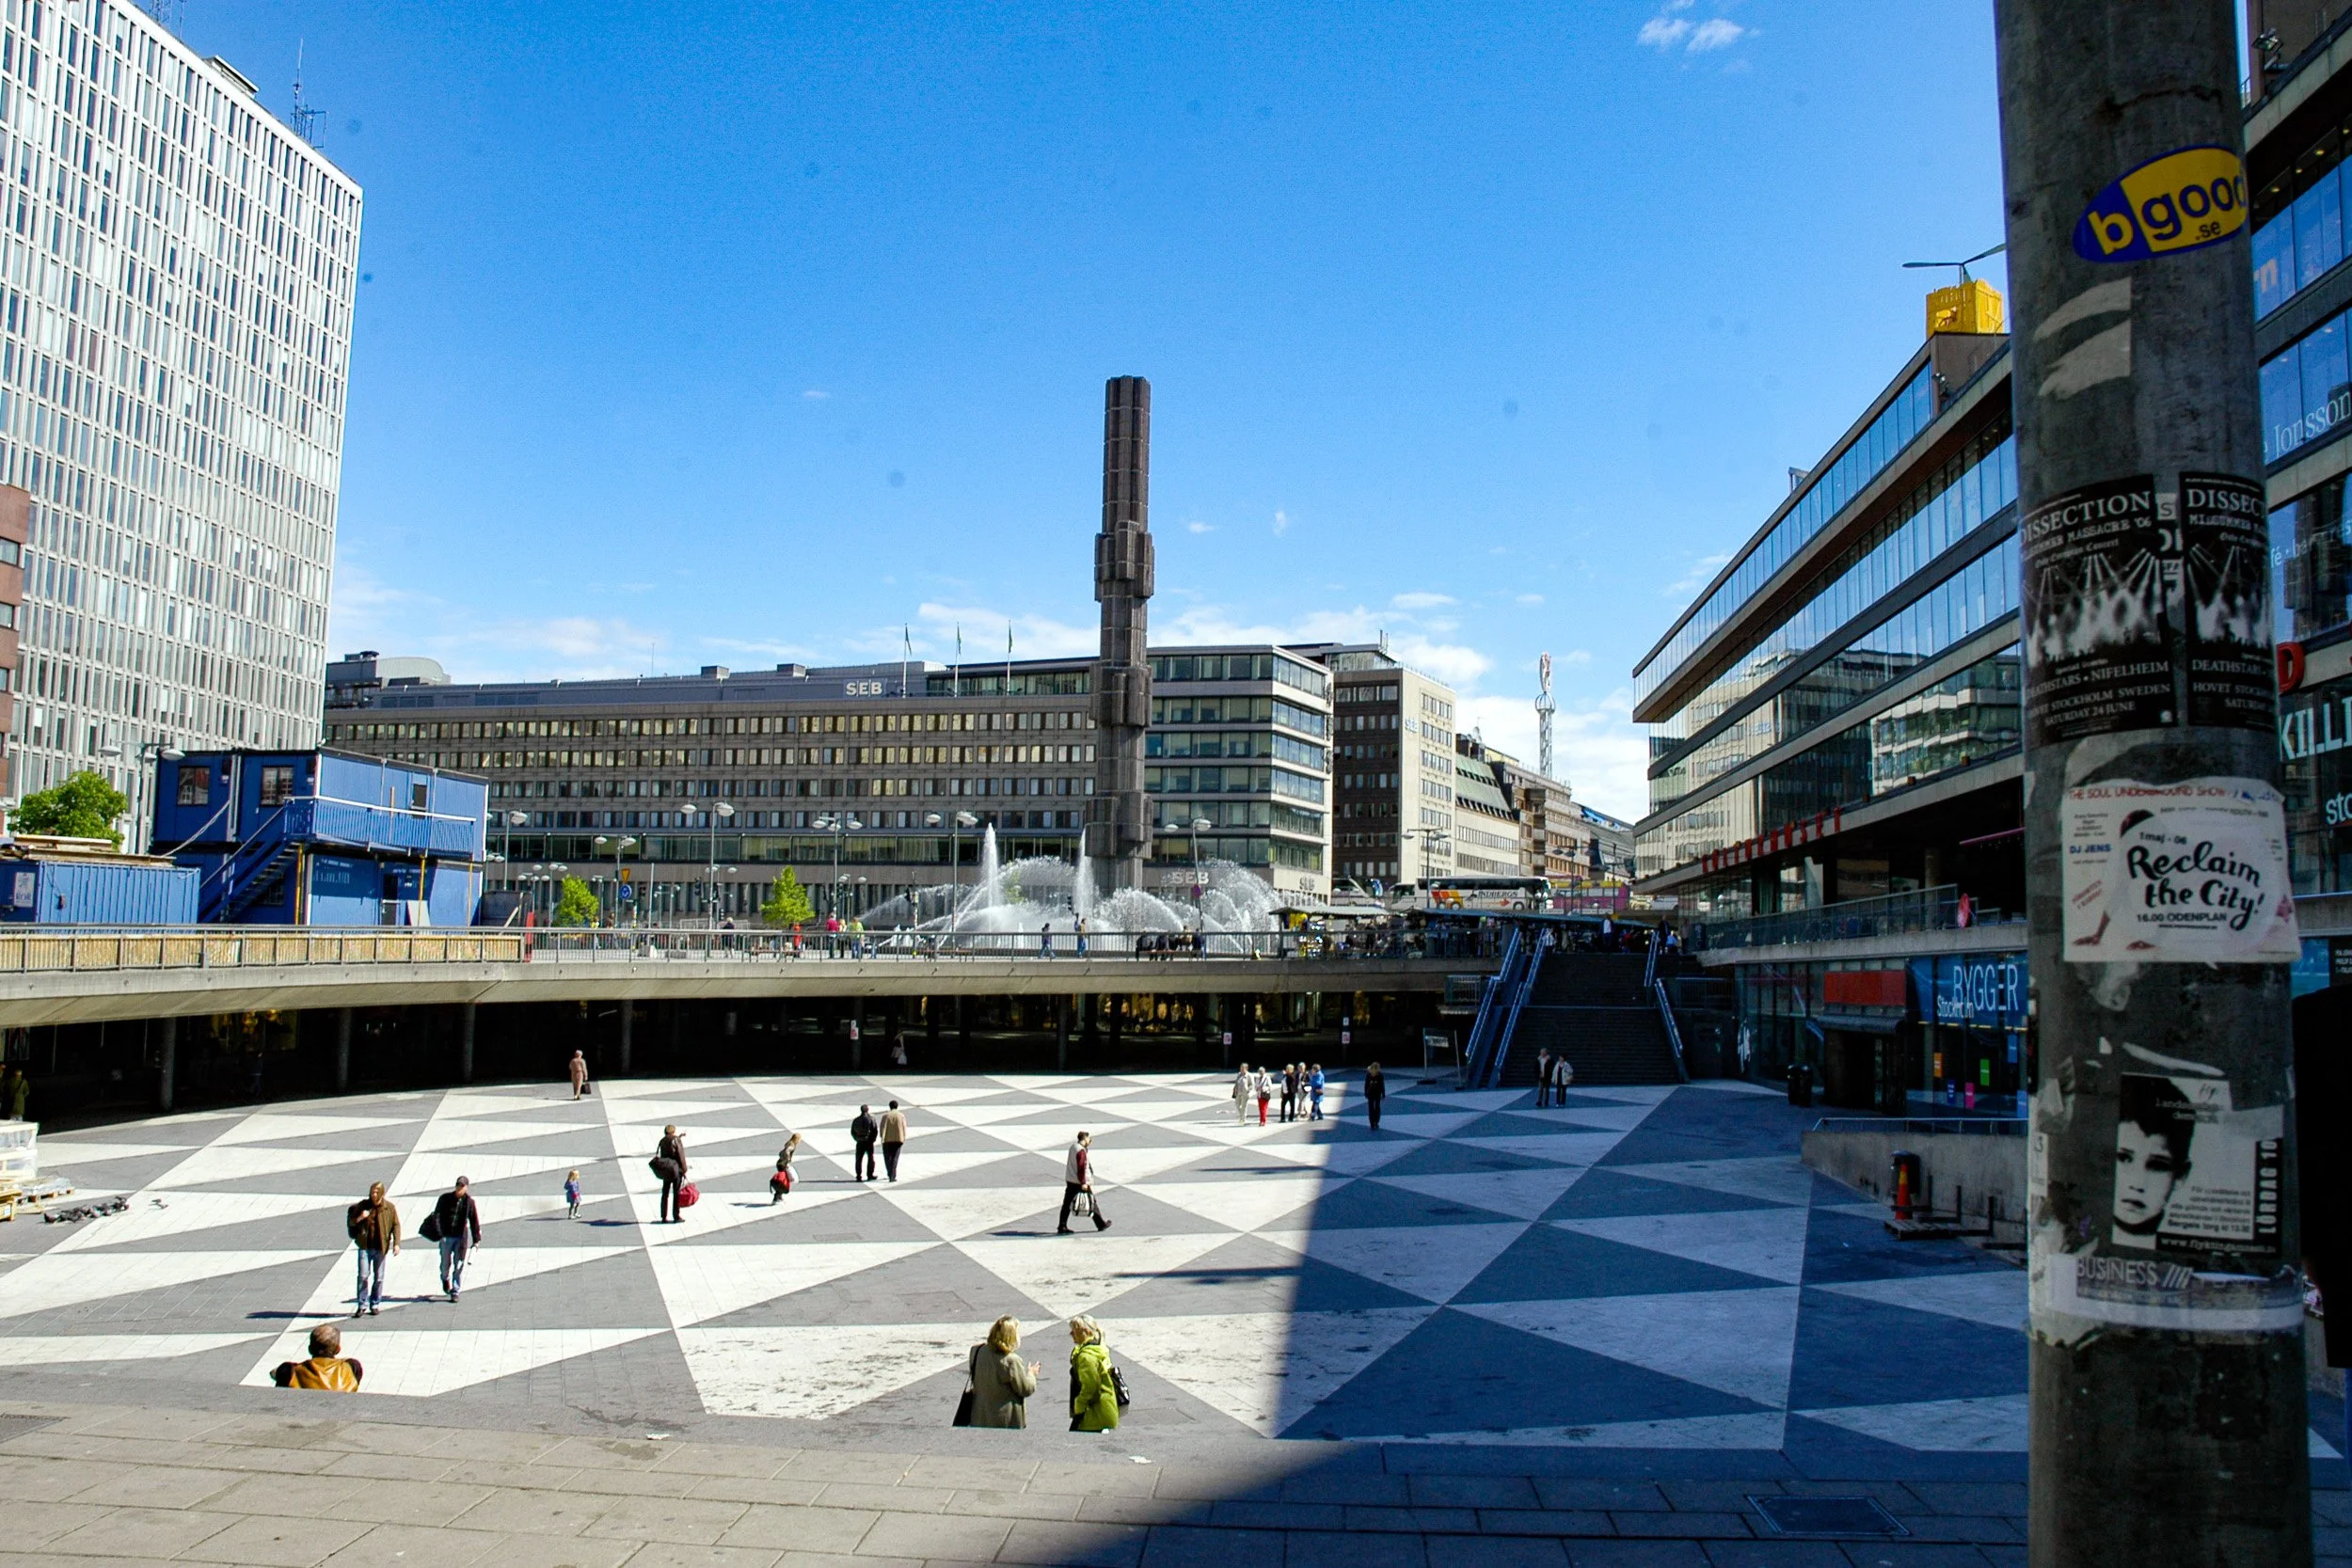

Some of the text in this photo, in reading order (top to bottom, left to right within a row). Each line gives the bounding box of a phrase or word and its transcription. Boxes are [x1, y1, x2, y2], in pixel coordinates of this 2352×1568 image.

[2196, 220, 2221, 240] .se
[2274, 390, 2352, 458] Jonsson
[2067, 518, 2131, 544] MASSACRE
[2090, 660, 2169, 682] NIFELHEIM
[846, 682, 882, 697] SEB
[2051, 689, 2114, 713] STOCKHOLM
[2117, 684, 2170, 698] SWEDEN
[2192, 681, 2233, 693] HOVET
[2106, 701, 2137, 716] JUNE
[2085, 843, 2112, 853] JENS
[2127, 841, 2260, 888] Reclaim
[2145, 878, 2193, 909] the
[2201, 879, 2265, 931] City!
[2137, 912, 2228, 923] 16.00 ODENPLAN
[1953, 963, 2019, 1011] BYGGER
[2077, 1257, 2158, 1286] BUSINESS
